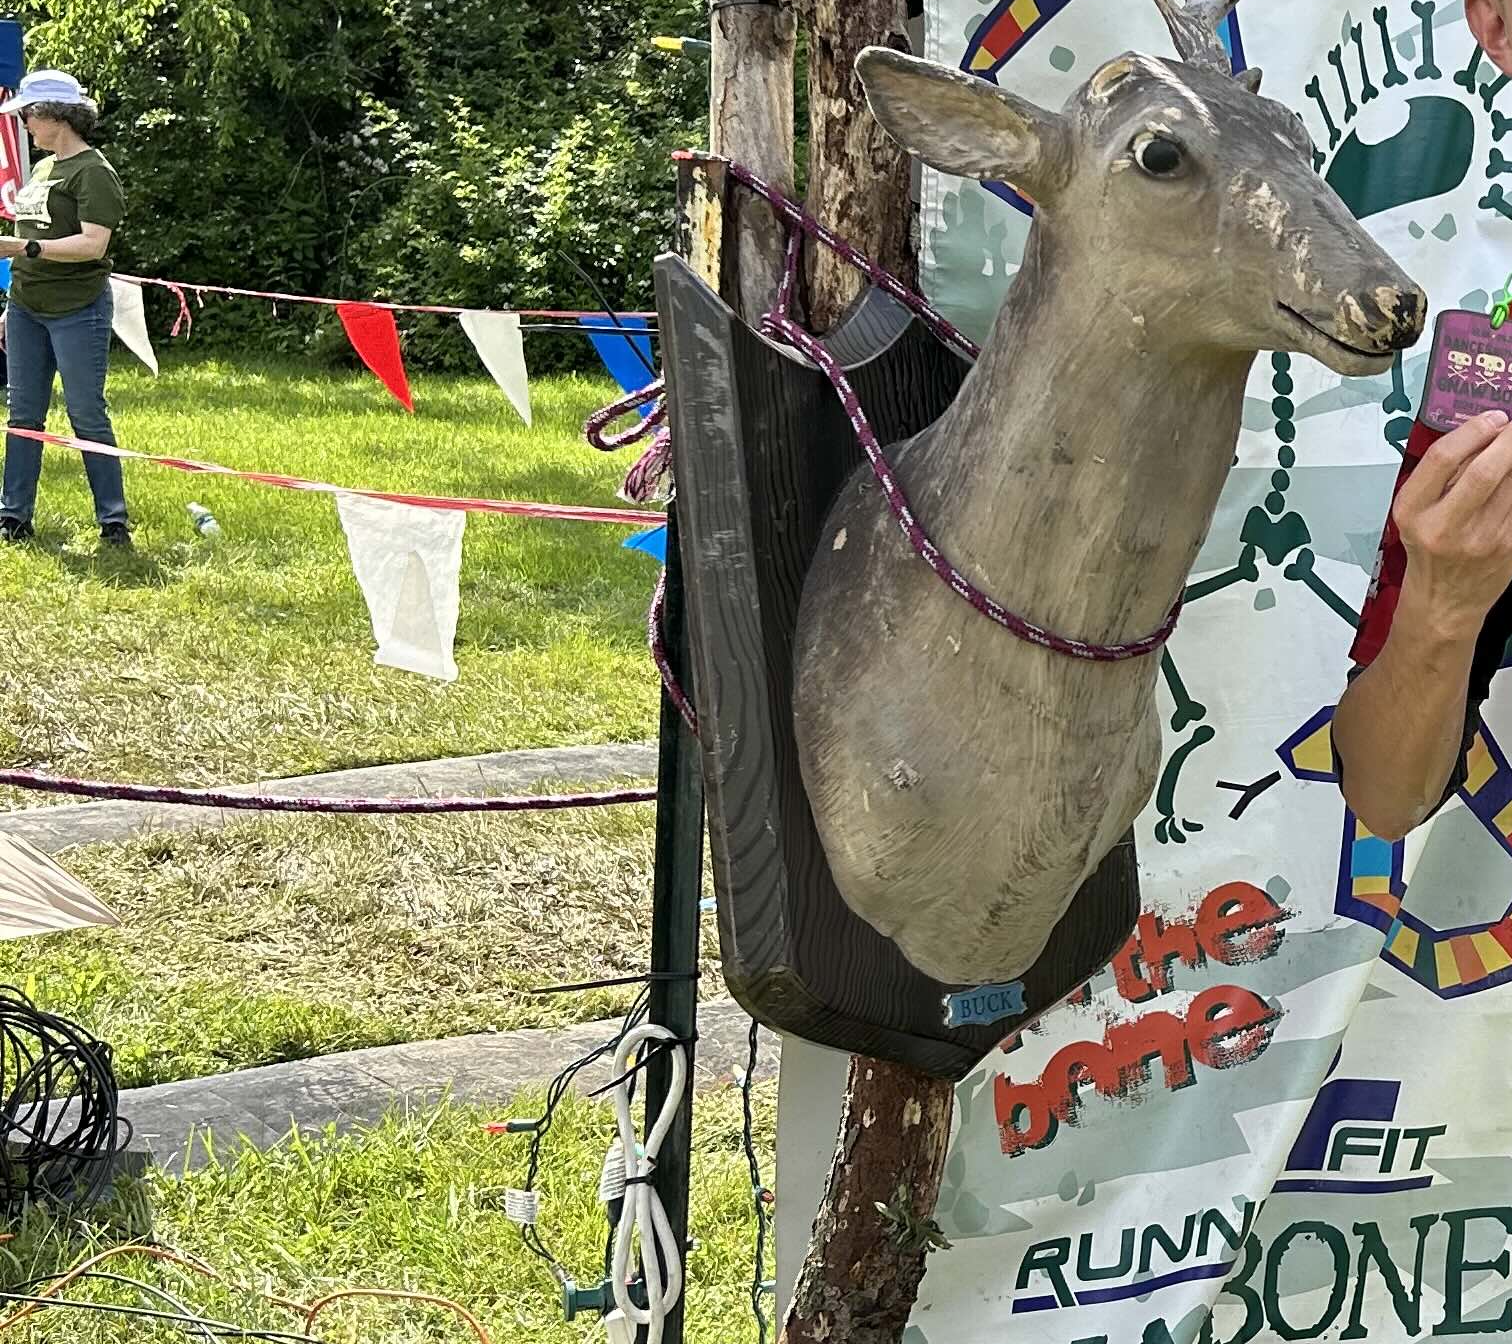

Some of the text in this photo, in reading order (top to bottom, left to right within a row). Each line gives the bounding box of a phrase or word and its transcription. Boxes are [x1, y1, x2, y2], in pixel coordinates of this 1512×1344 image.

[1111, 881, 1297, 1004] the
[960, 990, 1014, 1019] BUCK
[1015, 1123, 1448, 1309] RUNN FIT
